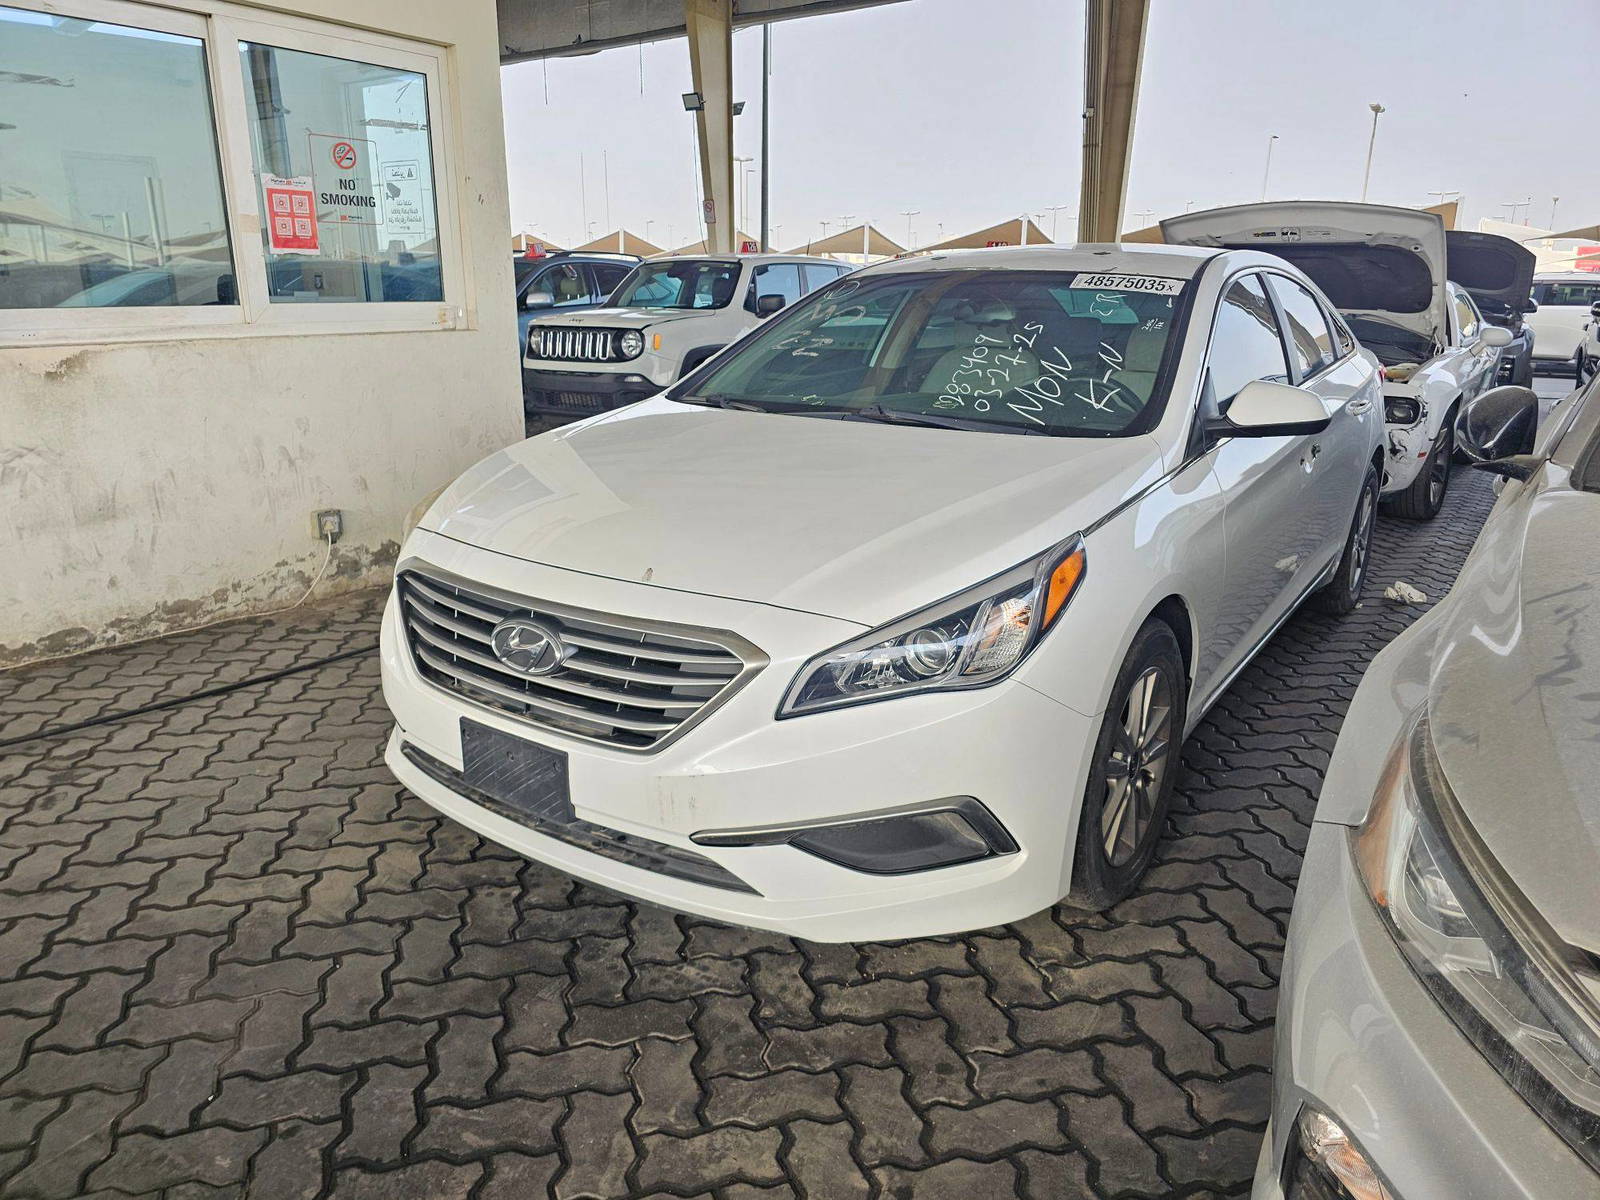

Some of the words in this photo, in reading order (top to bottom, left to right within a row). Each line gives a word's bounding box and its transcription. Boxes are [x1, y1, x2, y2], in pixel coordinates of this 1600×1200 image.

[339, 178, 356, 191] NO
[321, 192, 376, 208] SMOKING
[1006, 346, 1073, 427] MON
